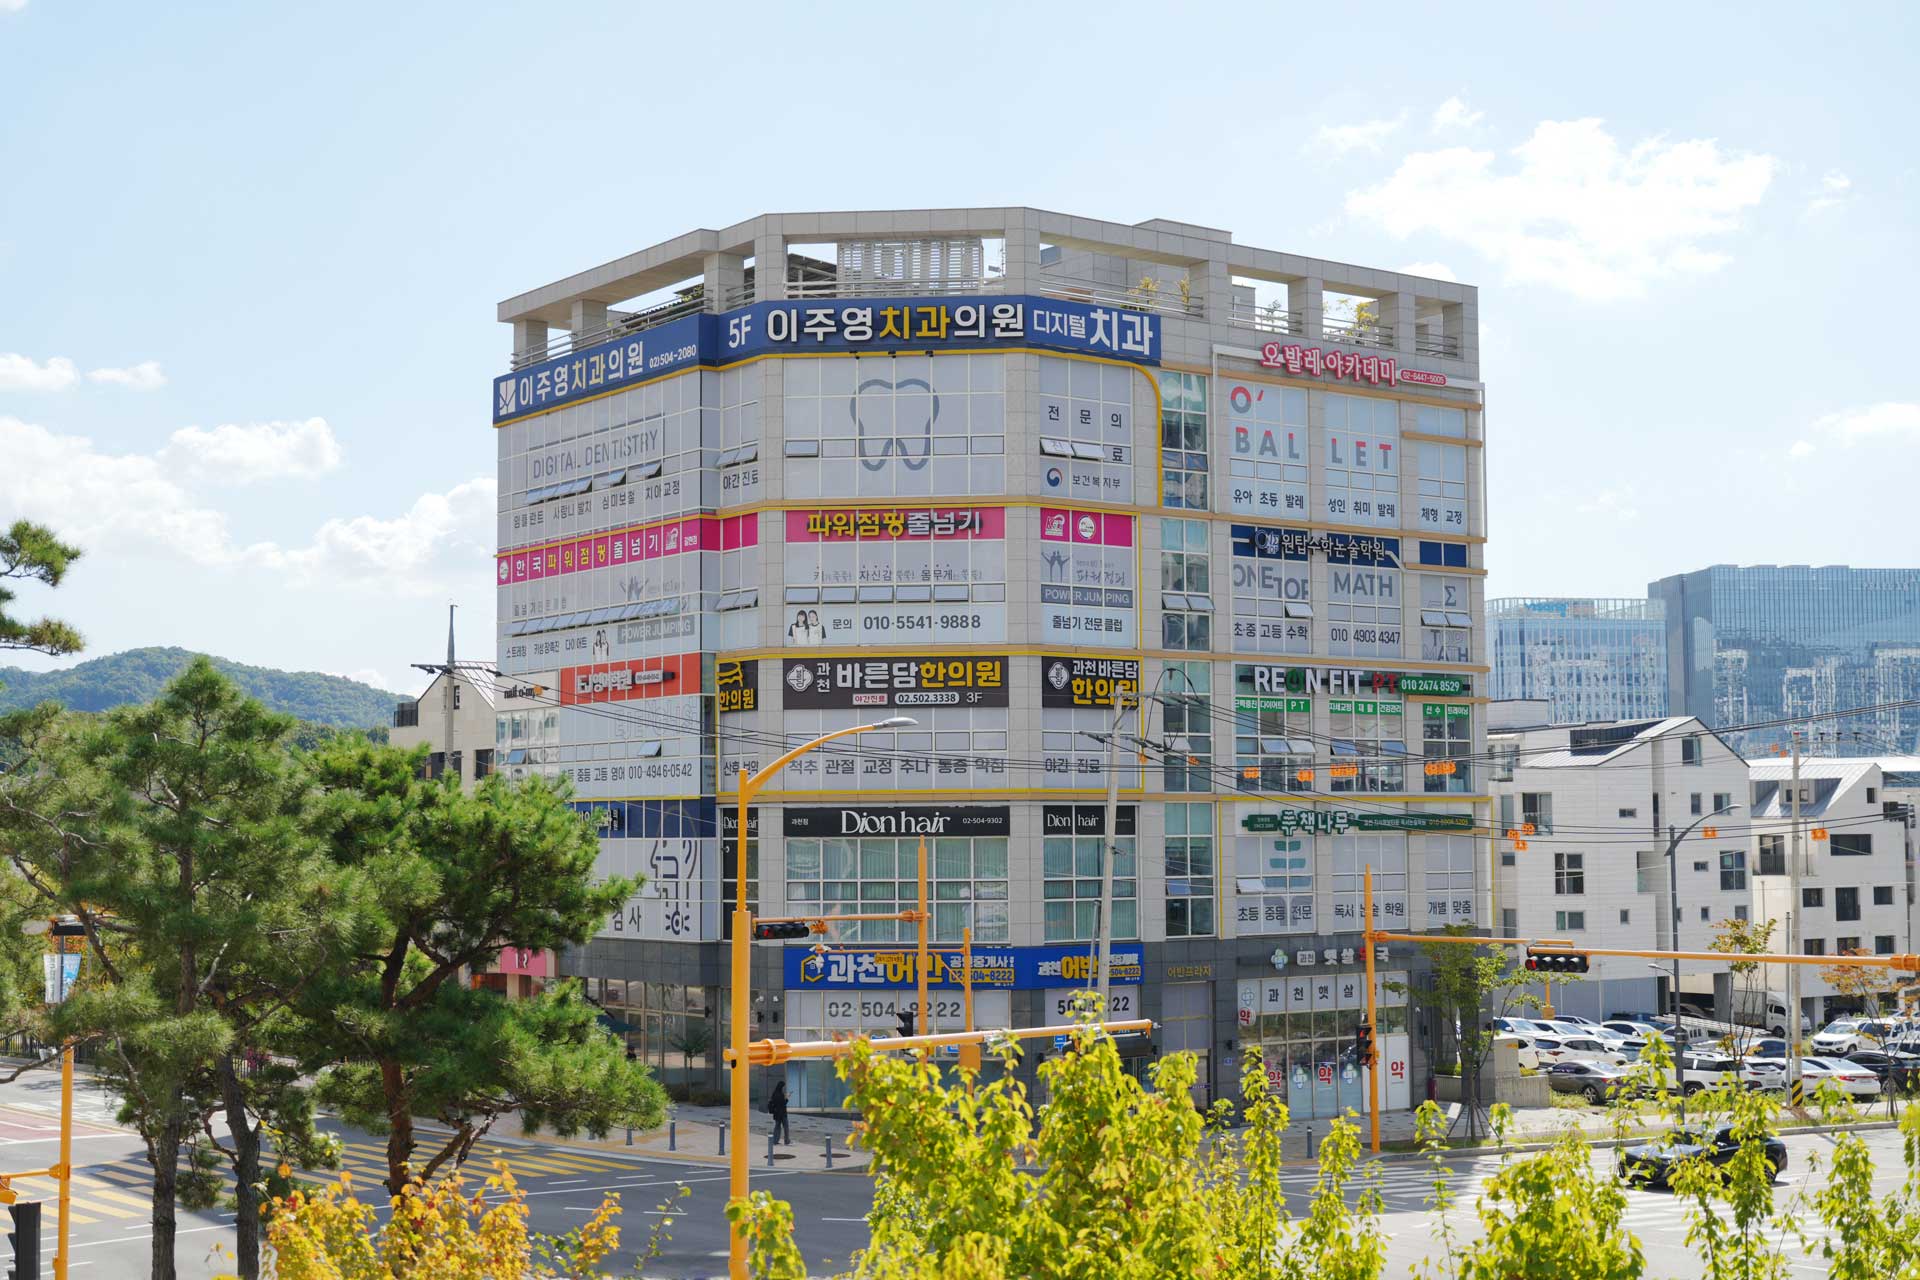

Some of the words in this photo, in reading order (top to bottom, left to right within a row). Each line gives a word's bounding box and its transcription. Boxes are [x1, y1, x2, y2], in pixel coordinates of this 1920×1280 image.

[728, 314, 752, 348] 5F
[767, 303, 1024, 342] 이주영치과의원
[1033, 309, 1086, 339] 디지털
[1090, 308, 1154, 355] 치과
[520, 340, 644, 406] 이주영치과의원
[649, 344, 697, 369] 02)504-2080
[585, 429, 658, 466] DENTISTRY
[1072, 474, 1121, 489] 보건복지부
[1233, 489, 1252, 505] 유아
[1259, 491, 1278, 507] 초등
[1285, 493, 1304, 510] 발레
[1328, 498, 1346, 514] 성인
[1353, 501, 1371, 516] 취미
[1377, 502, 1395, 518] 발레
[807, 511, 981, 538] 파워점핑줄넘기
[1421, 507, 1438, 523] 체형
[1445, 509, 1462, 525] 교정
[1334, 571, 1393, 598] MATH
[832, 618, 852, 630] 문의
[1260, 624, 1282, 639] 고등
[1286, 625, 1308, 640] 수학
[1331, 628, 1348, 642] 010
[1353, 630, 1376, 643] 4903
[1378, 631, 1400, 645] 4347
[836, 660, 1002, 689] 바른담한의원
[1072, 659, 1097, 676] 과천
[1098, 661, 1138, 679] 바른담
[1329, 667, 1364, 695] FIT
[1372, 671, 1398, 695] PT
[1401, 679, 1417, 690] 010
[1418, 680, 1439, 692] 2474
[1440, 681, 1460, 693] 8529
[898, 693, 957, 704] 02.502.3338
[966, 692, 983, 703] 3F
[825, 759, 855, 775] 관절
[863, 759, 892, 775] 교정
[900, 758, 930, 774] 추나
[746, 815, 759, 830] air
[840, 810, 896, 834] Dion
[900, 810, 951, 834] hair
[962, 817, 1003, 825] 02-504-9302
[1047, 813, 1071, 828] Dion
[1077, 813, 1100, 828] hair
[1237, 906, 1259, 922] 초등
[1291, 904, 1312, 921] 전문
[1335, 903, 1355, 919] 독서
[1384, 902, 1405, 917] 학원
[1428, 901, 1447, 916] 개별
[1452, 899, 1472, 915] 맞춤
[1318, 1066, 1332, 1085] 약
[1390, 1061, 1405, 1080] 약
